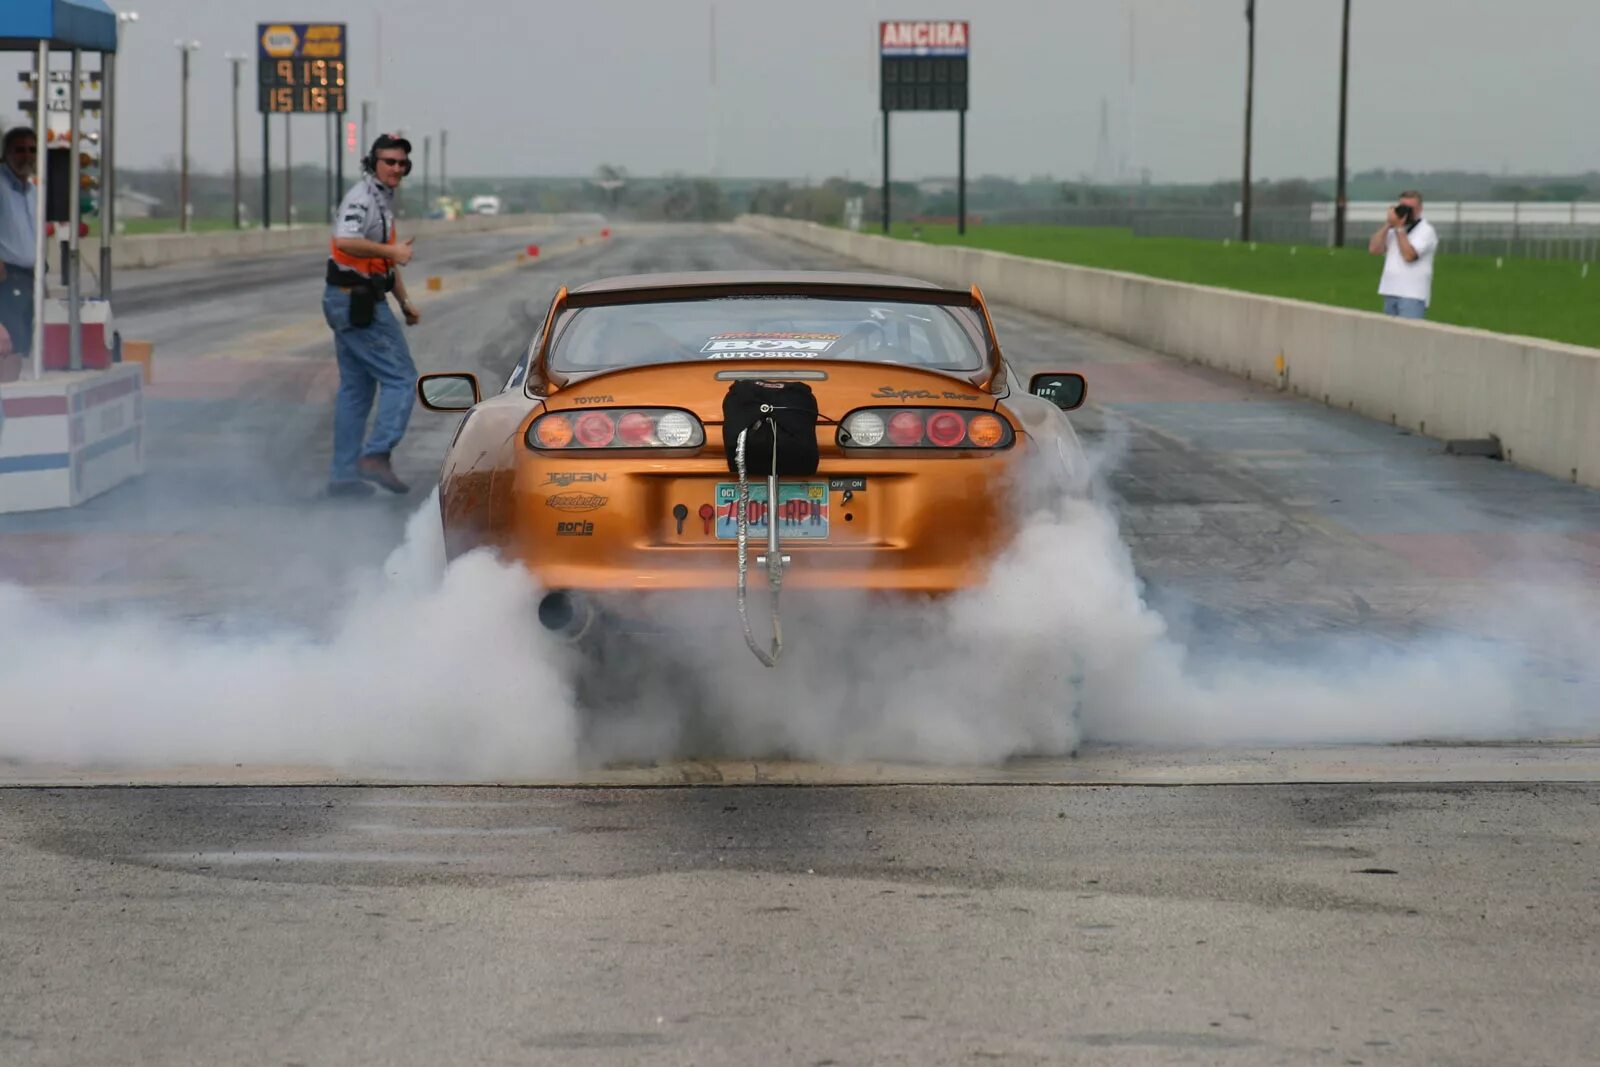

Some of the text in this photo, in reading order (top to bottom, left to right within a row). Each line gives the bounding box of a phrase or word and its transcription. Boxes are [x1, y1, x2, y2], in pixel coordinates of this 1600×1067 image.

[707, 351, 819, 359] AUTOSHOP
[574, 395, 614, 404] TOYOTA
[721, 488, 735, 497] OCT
